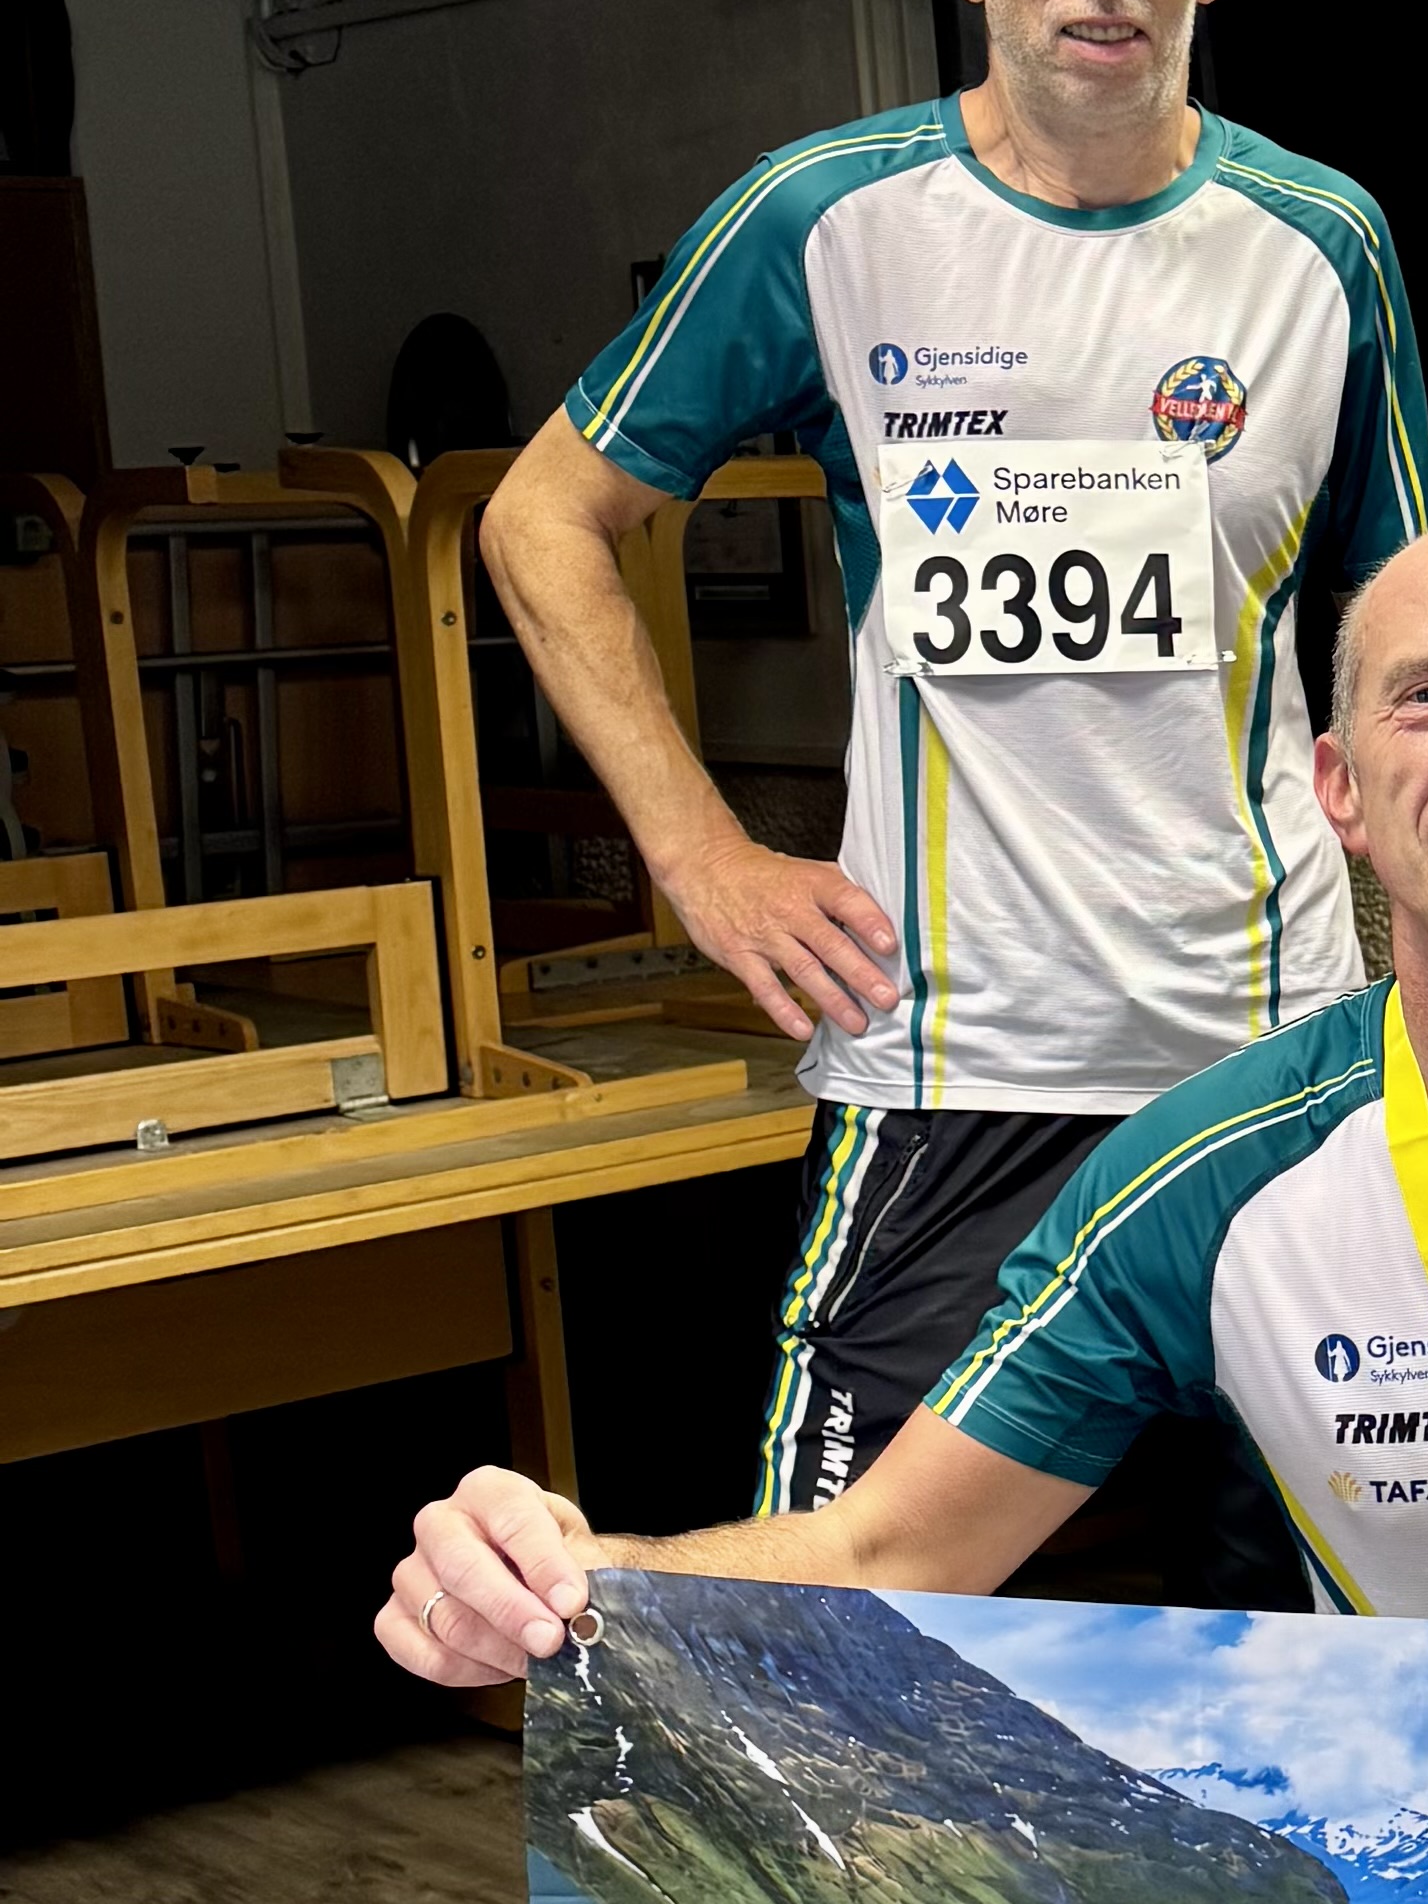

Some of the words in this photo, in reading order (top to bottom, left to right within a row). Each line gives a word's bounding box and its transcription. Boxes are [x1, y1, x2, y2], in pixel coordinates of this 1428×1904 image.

[914, 346, 1028, 372] Gjensidige
[884, 410, 1008, 438] TRIMTEX
[993, 466, 1181, 496] Sparebanken
[997, 501, 1068, 524] Møre
[913, 550, 1182, 664] 3394
[813, 1388, 855, 1511] TRIMT
